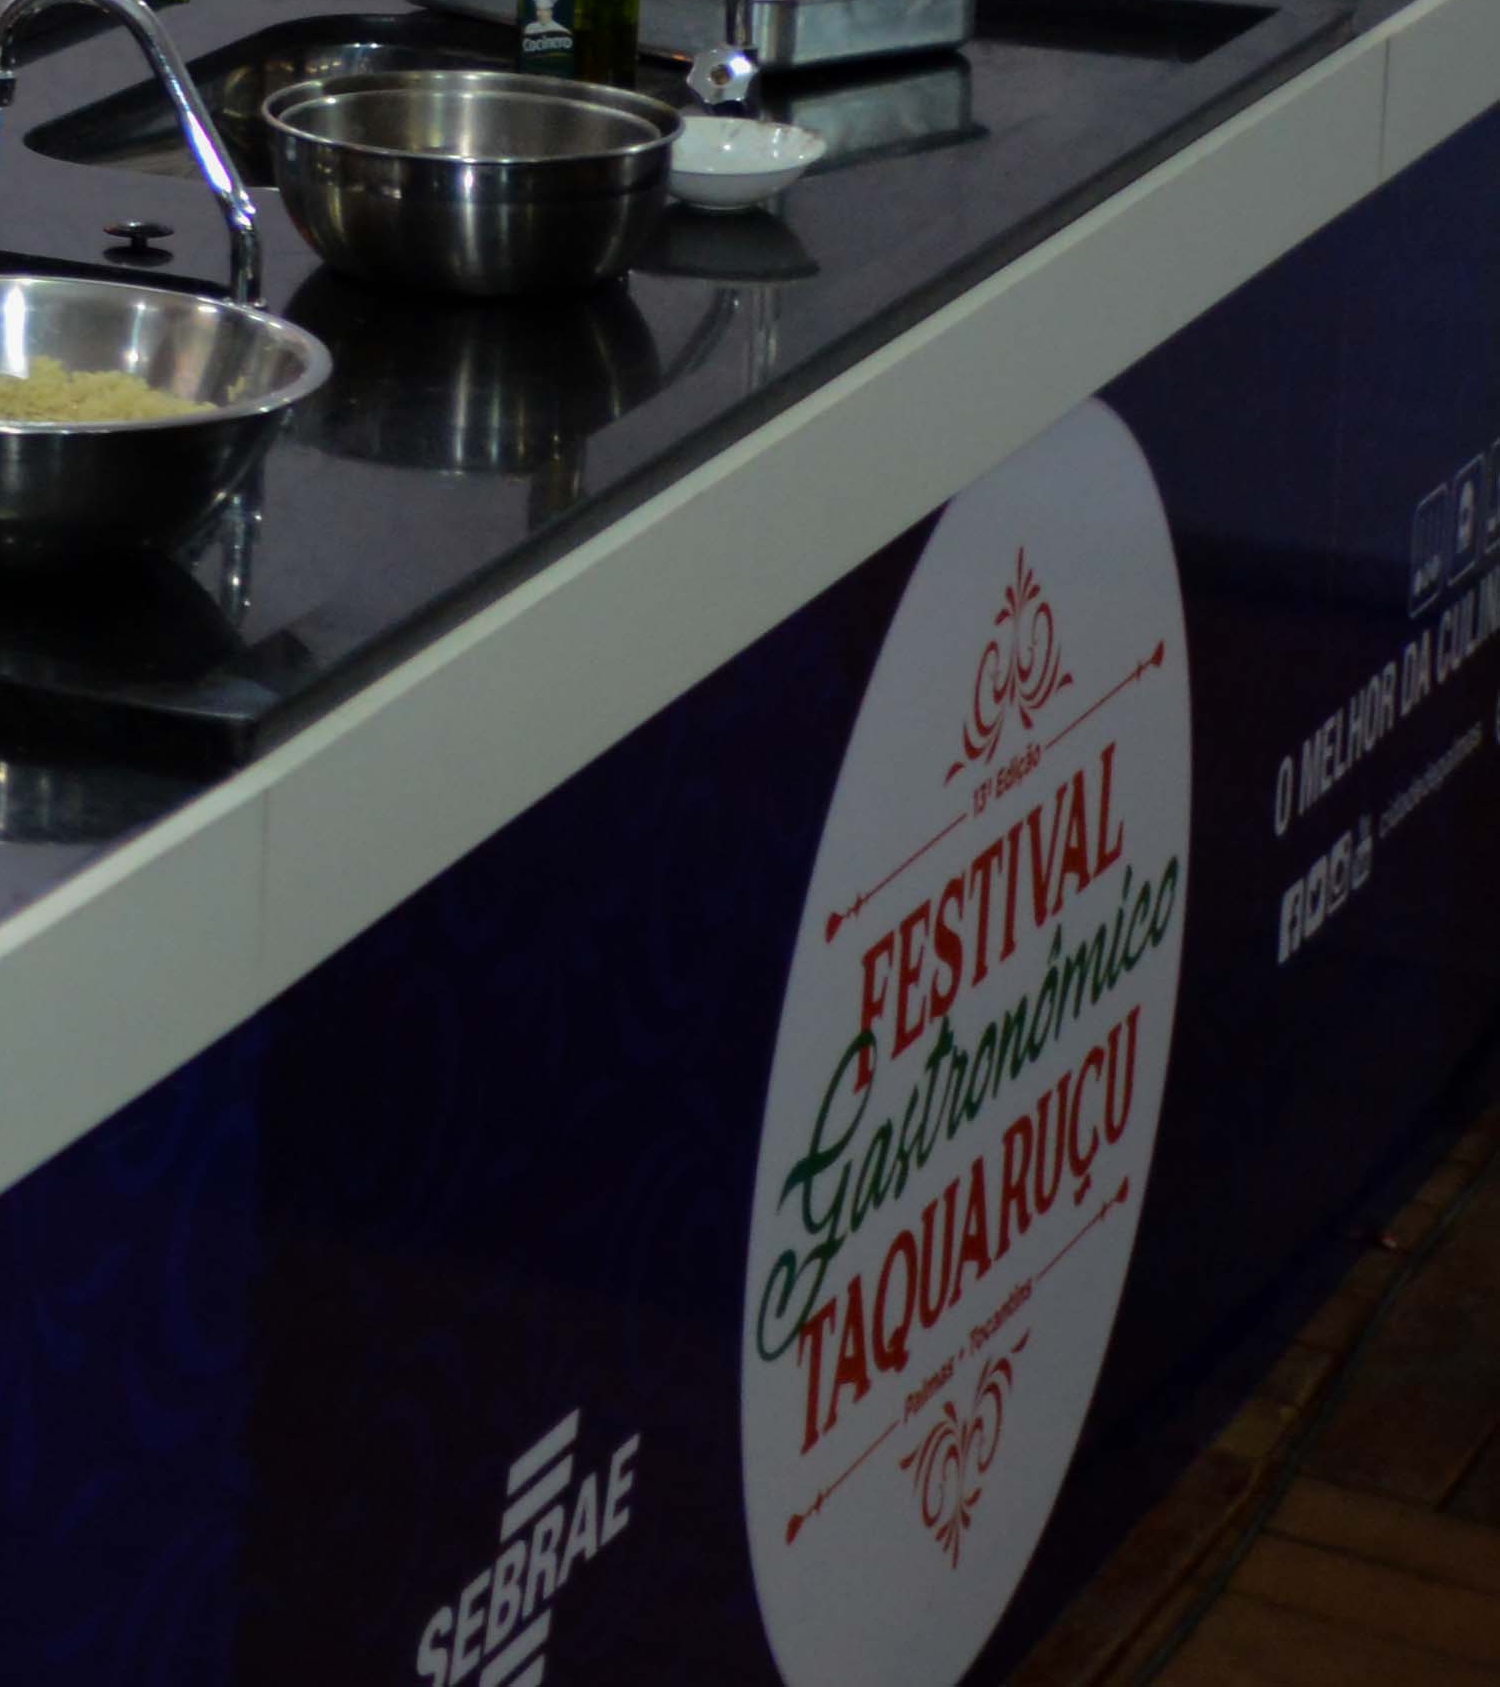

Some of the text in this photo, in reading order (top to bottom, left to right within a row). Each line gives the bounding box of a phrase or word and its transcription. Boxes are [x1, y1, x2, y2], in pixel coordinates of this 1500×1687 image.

[522, 35, 573, 53] Cocinero
[995, 743, 1041, 799] Edição
[1274, 754, 1293, 837] O
[1298, 660, 1397, 816] MELHOR
[1400, 628, 1431, 718] DA
[855, 742, 1124, 1095] FESTIVAL
[799, 1005, 1140, 1455] TAQUARUÇU
[904, 1277, 1033, 1423] Palmas Tocantins
[416, 1432, 642, 1687] SEBRAE
